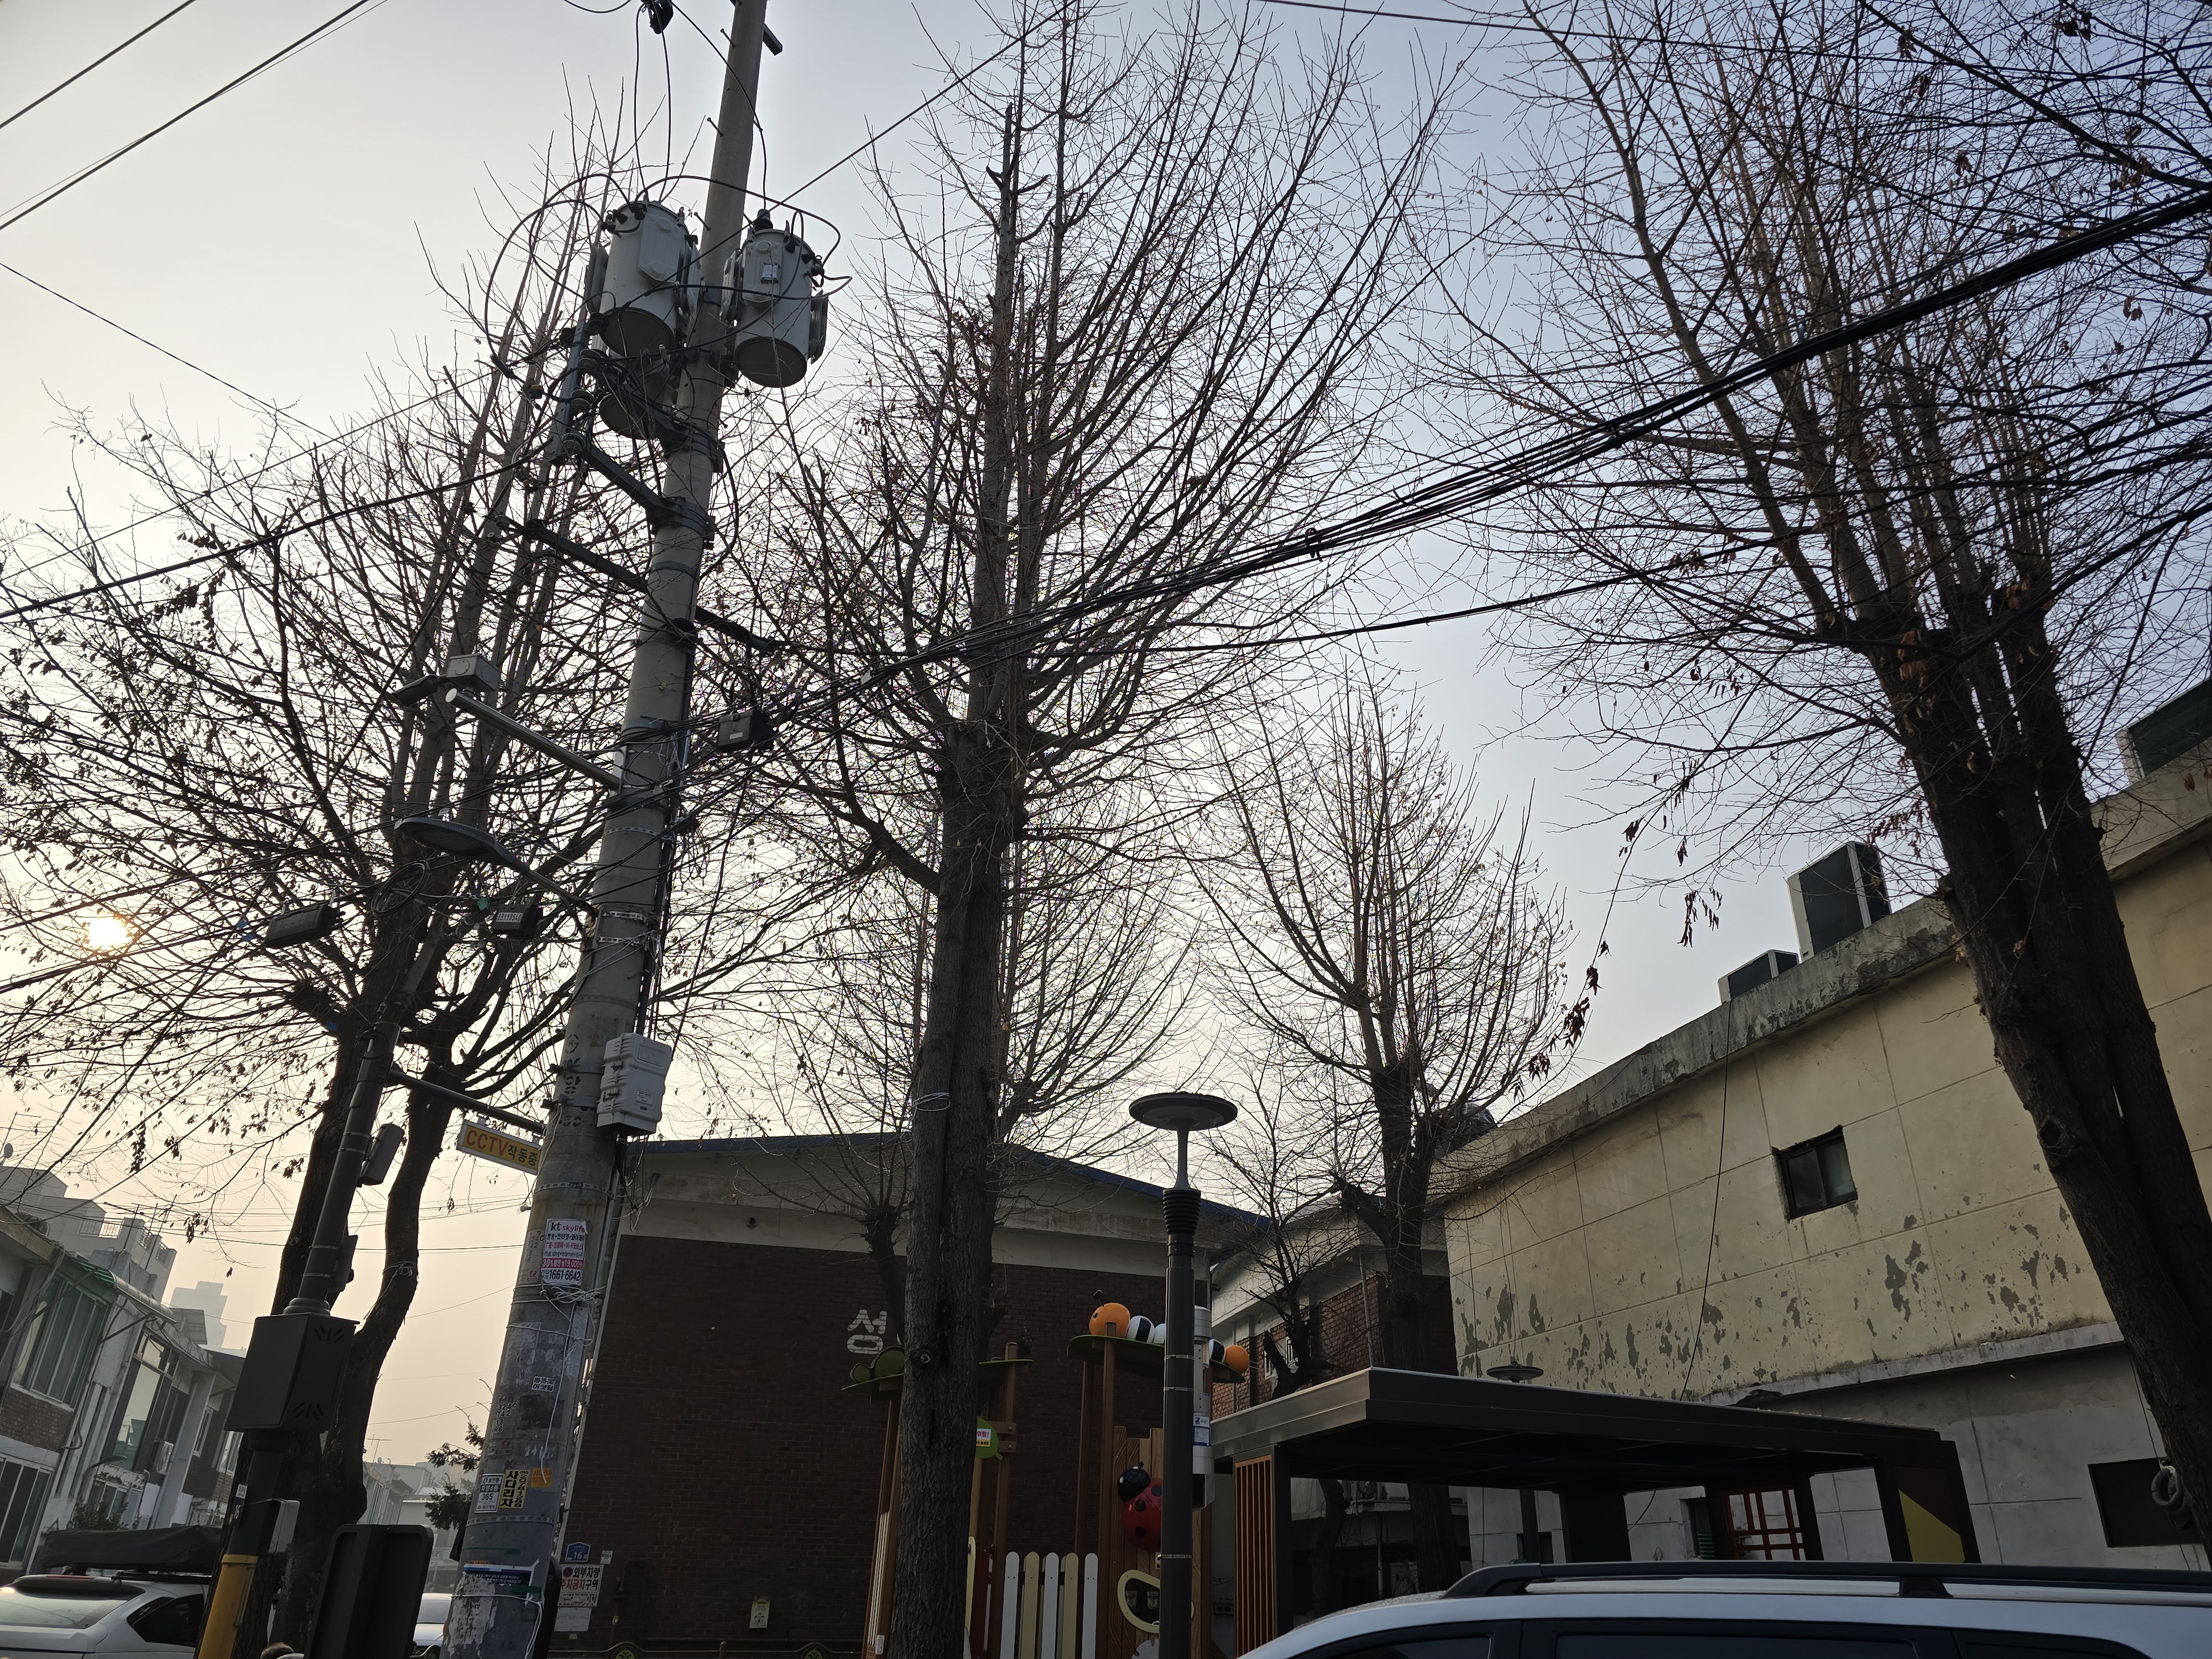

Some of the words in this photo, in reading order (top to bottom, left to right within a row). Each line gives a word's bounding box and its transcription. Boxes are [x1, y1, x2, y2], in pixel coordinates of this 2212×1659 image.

[466, 1129, 539, 1166] CCTV작동중
[550, 1222, 561, 1232] kt
[562, 1224, 585, 1233] skylife
[847, 1309, 888, 1355] 성
[500, 1471, 519, 1507] 사다리차
[481, 1493, 493, 1501] 365
[573, 1567, 600, 1578] 외부차량
[561, 1579, 598, 1590] 주차금지구역
